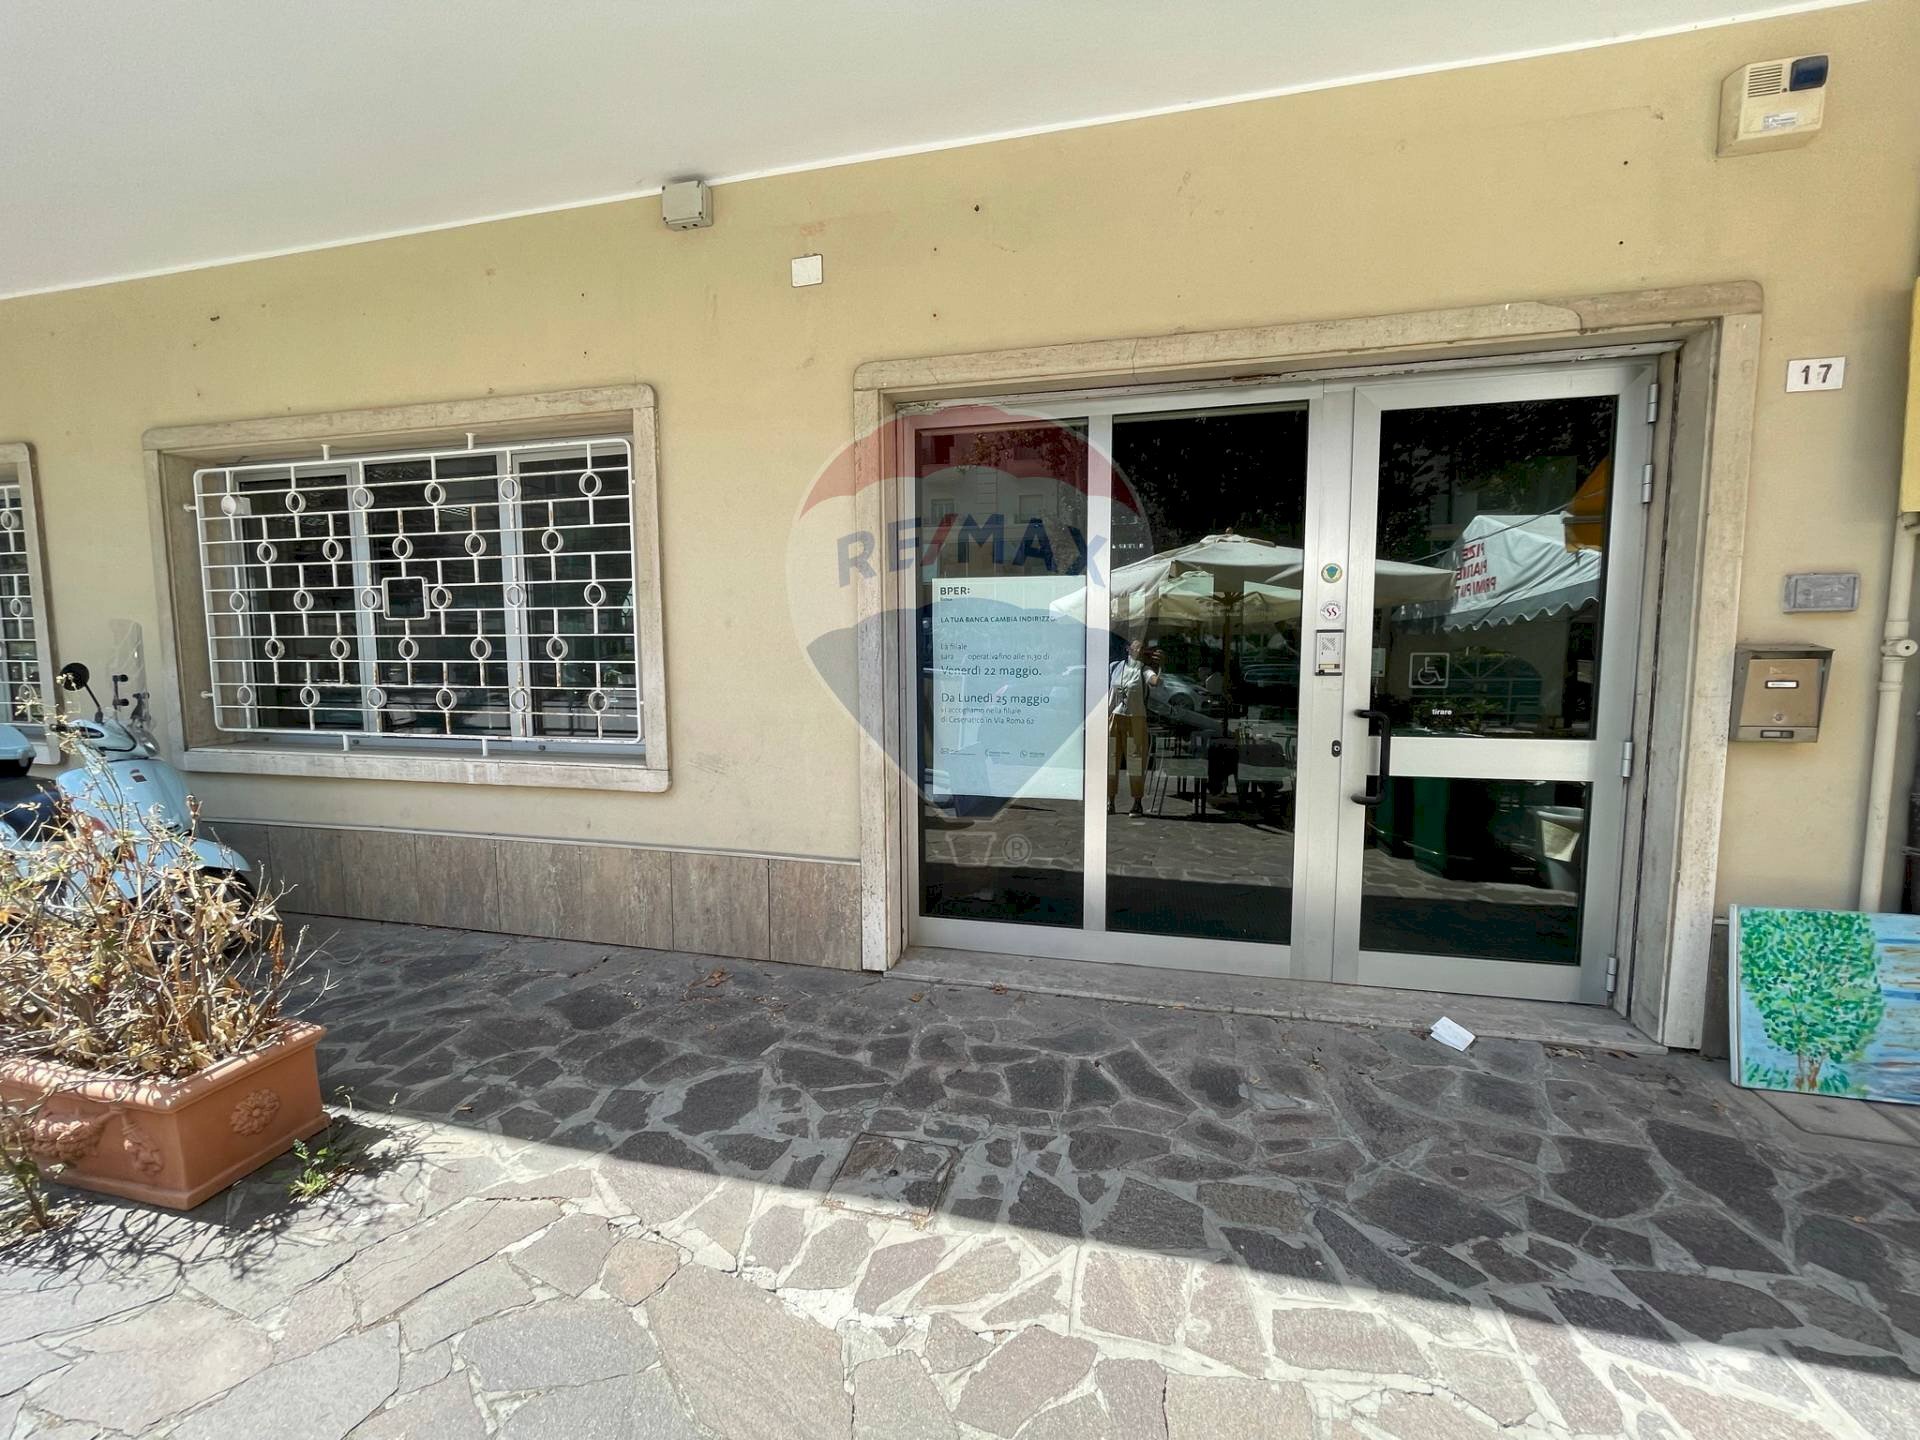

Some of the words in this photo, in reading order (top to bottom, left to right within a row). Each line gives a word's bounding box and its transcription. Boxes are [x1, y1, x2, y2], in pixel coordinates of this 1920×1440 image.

[1800, 363, 1834, 386] 17
[940, 616, 950, 624] LA
[951, 616, 964, 624] TUA
[965, 616, 989, 624] BANCA
[990, 615, 1018, 623] CAMBIA
[984, 668, 997, 676] 22
[999, 665, 1042, 679] maggio.
[941, 692, 955, 703] Da
[996, 695, 1008, 706] 25
[1010, 693, 1050, 707] maggio
[993, 716, 1005, 724] Via
[1006, 717, 1025, 725] Roma
